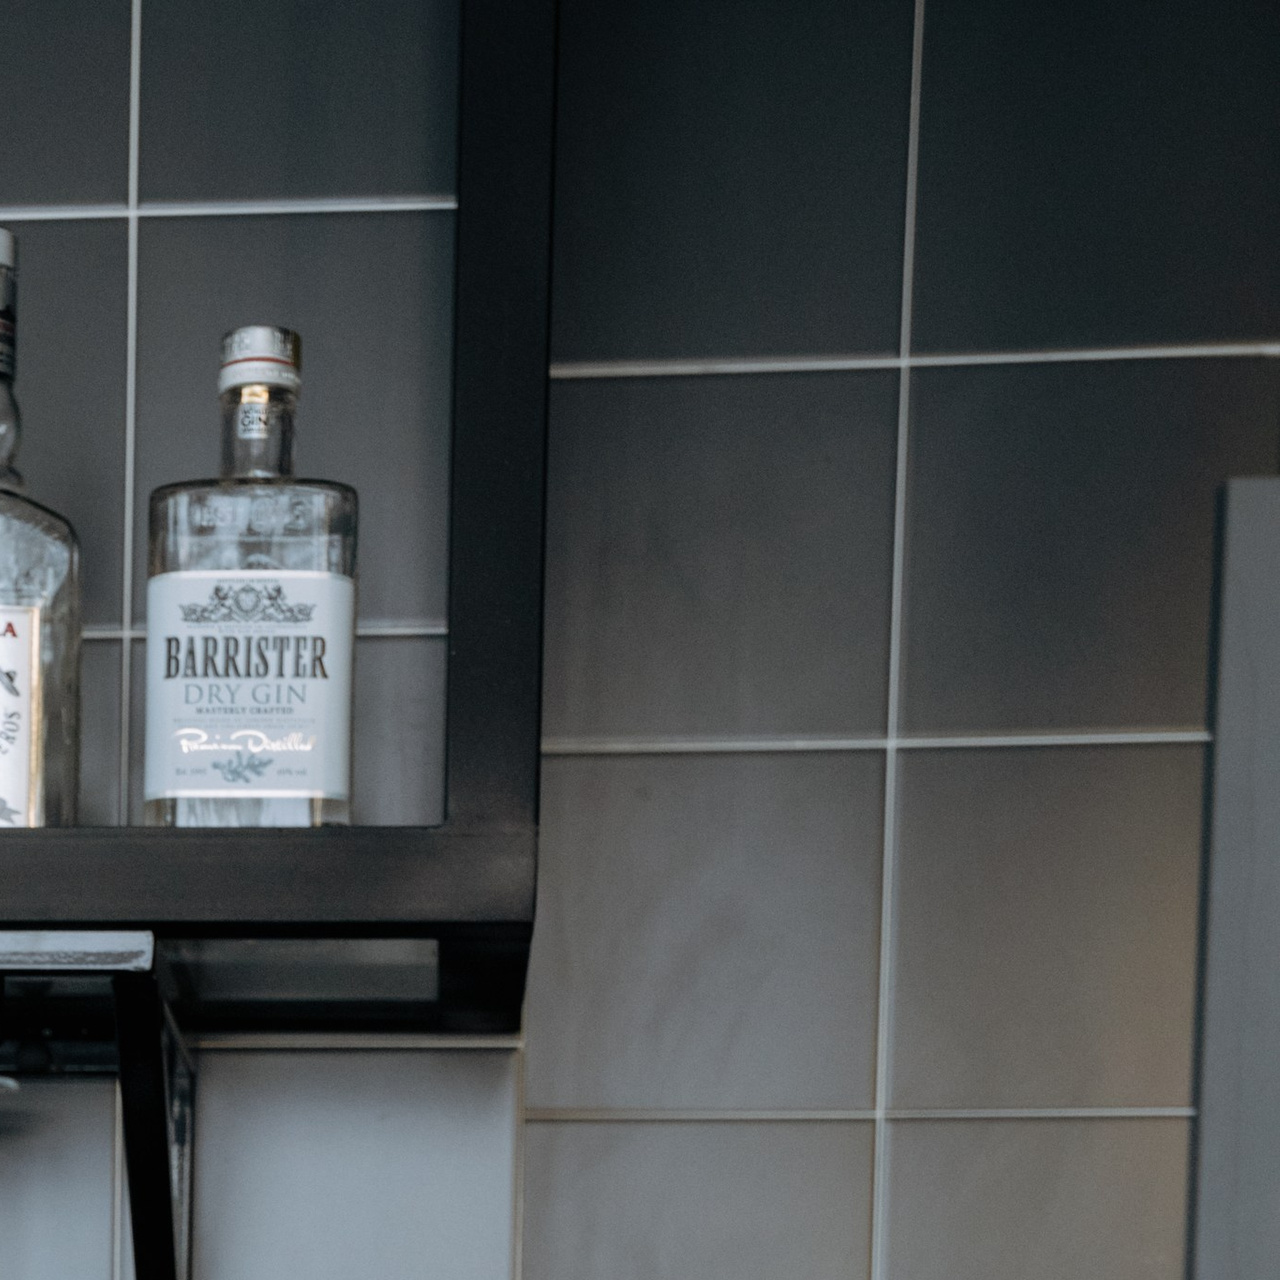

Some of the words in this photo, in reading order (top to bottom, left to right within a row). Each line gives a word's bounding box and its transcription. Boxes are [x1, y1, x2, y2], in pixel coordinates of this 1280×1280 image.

[164, 636, 329, 680] BARRISTER
[184, 683, 241, 705] DRY
[251, 683, 307, 705] GIN
